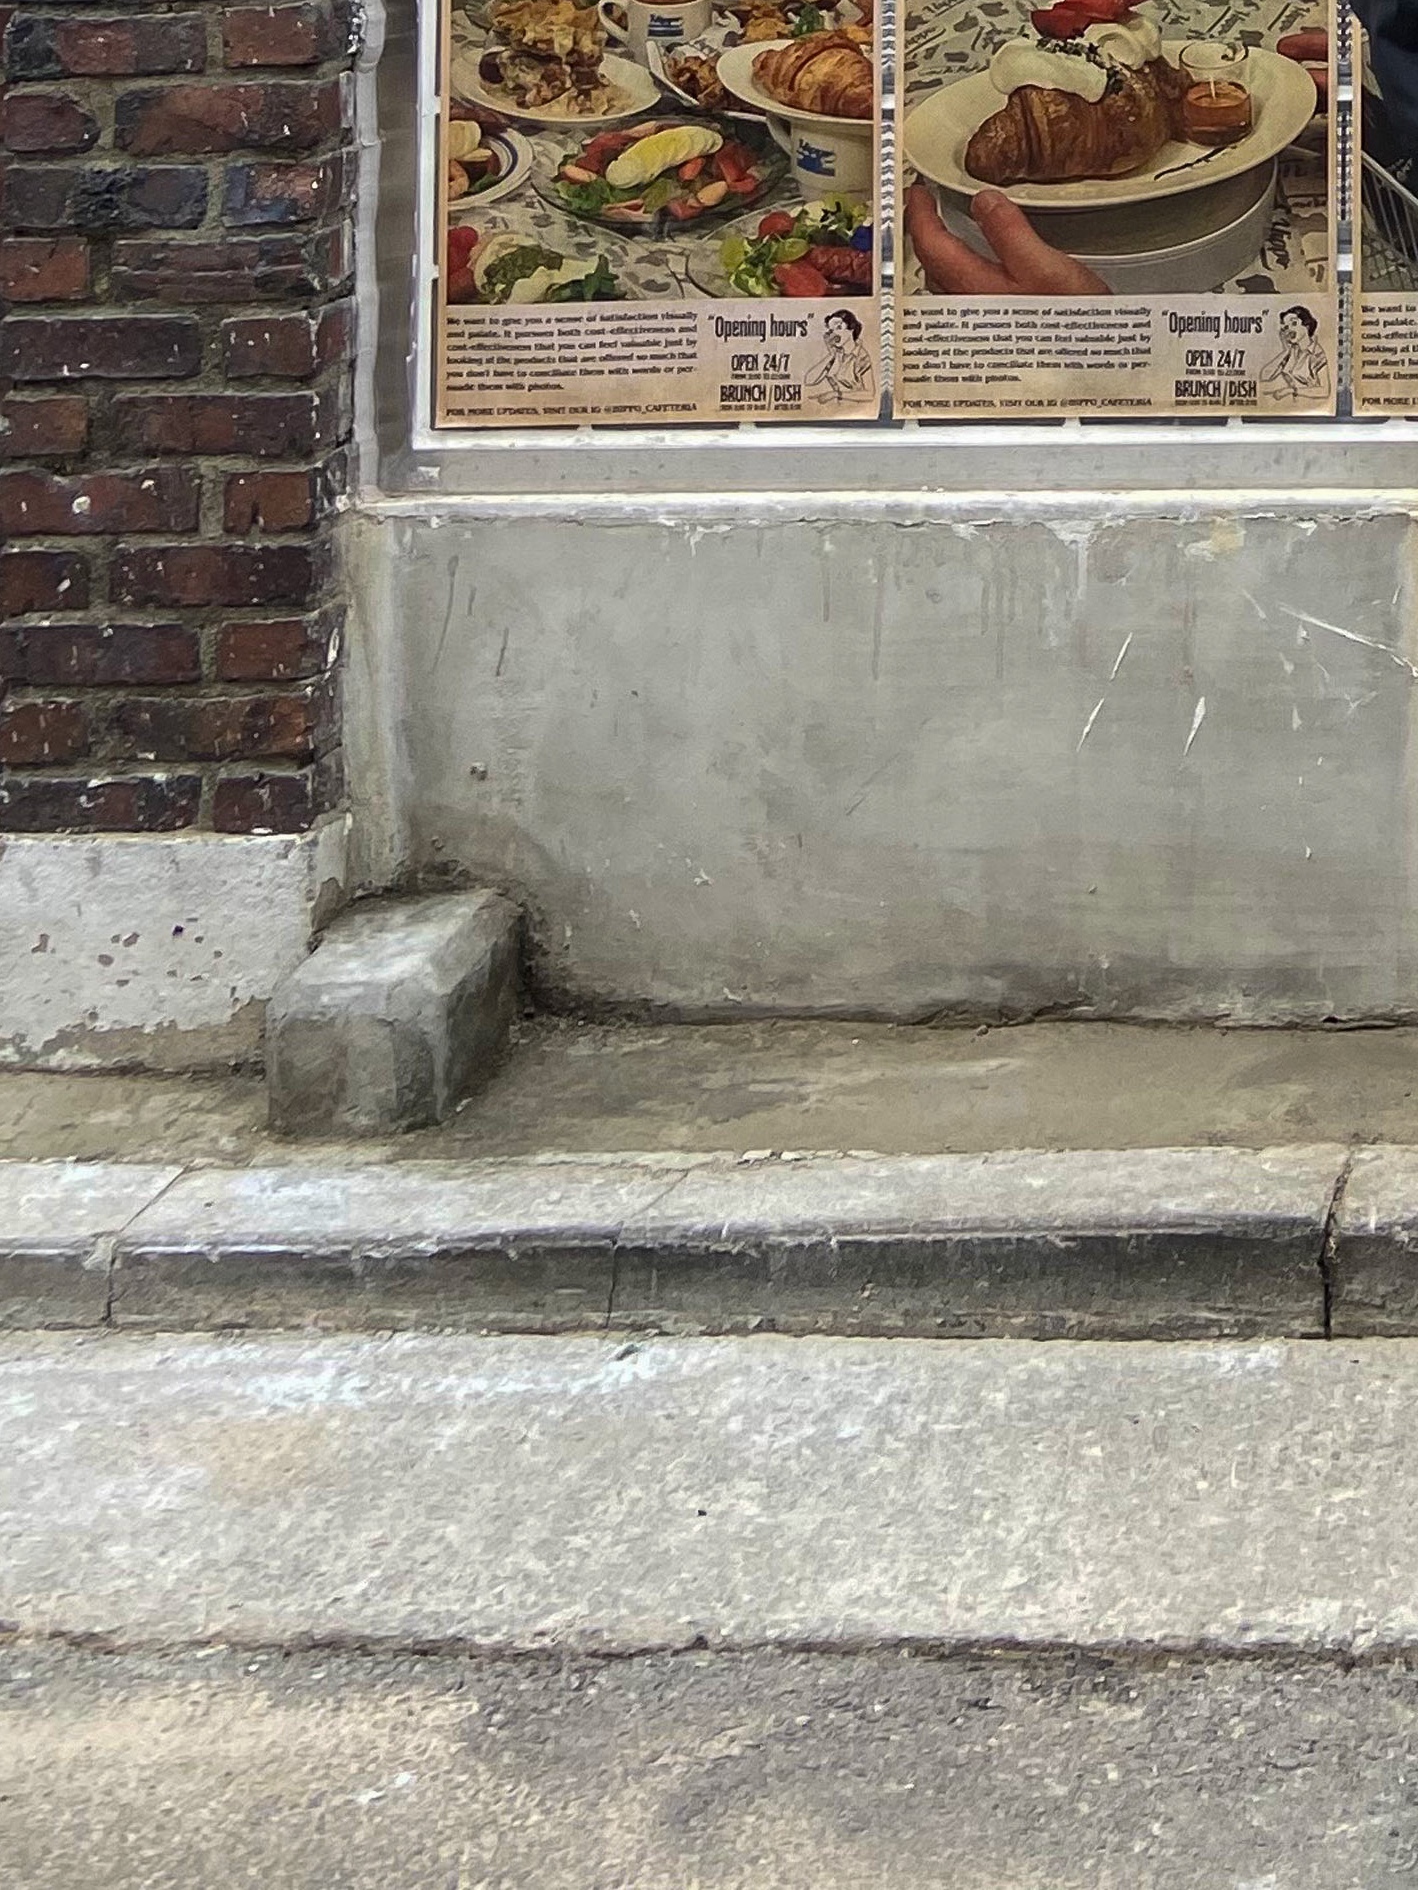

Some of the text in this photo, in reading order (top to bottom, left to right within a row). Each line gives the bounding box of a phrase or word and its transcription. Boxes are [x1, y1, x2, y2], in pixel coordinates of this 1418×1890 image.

[731, 352, 791, 375] OPEN 24/7
[1185, 348, 1246, 370] OPEN 24/7
[720, 384, 767, 403] BRUNCH
[773, 384, 802, 403] DISH
[1174, 379, 1222, 398] BRUNCH
[1228, 380, 1257, 399] DISH
